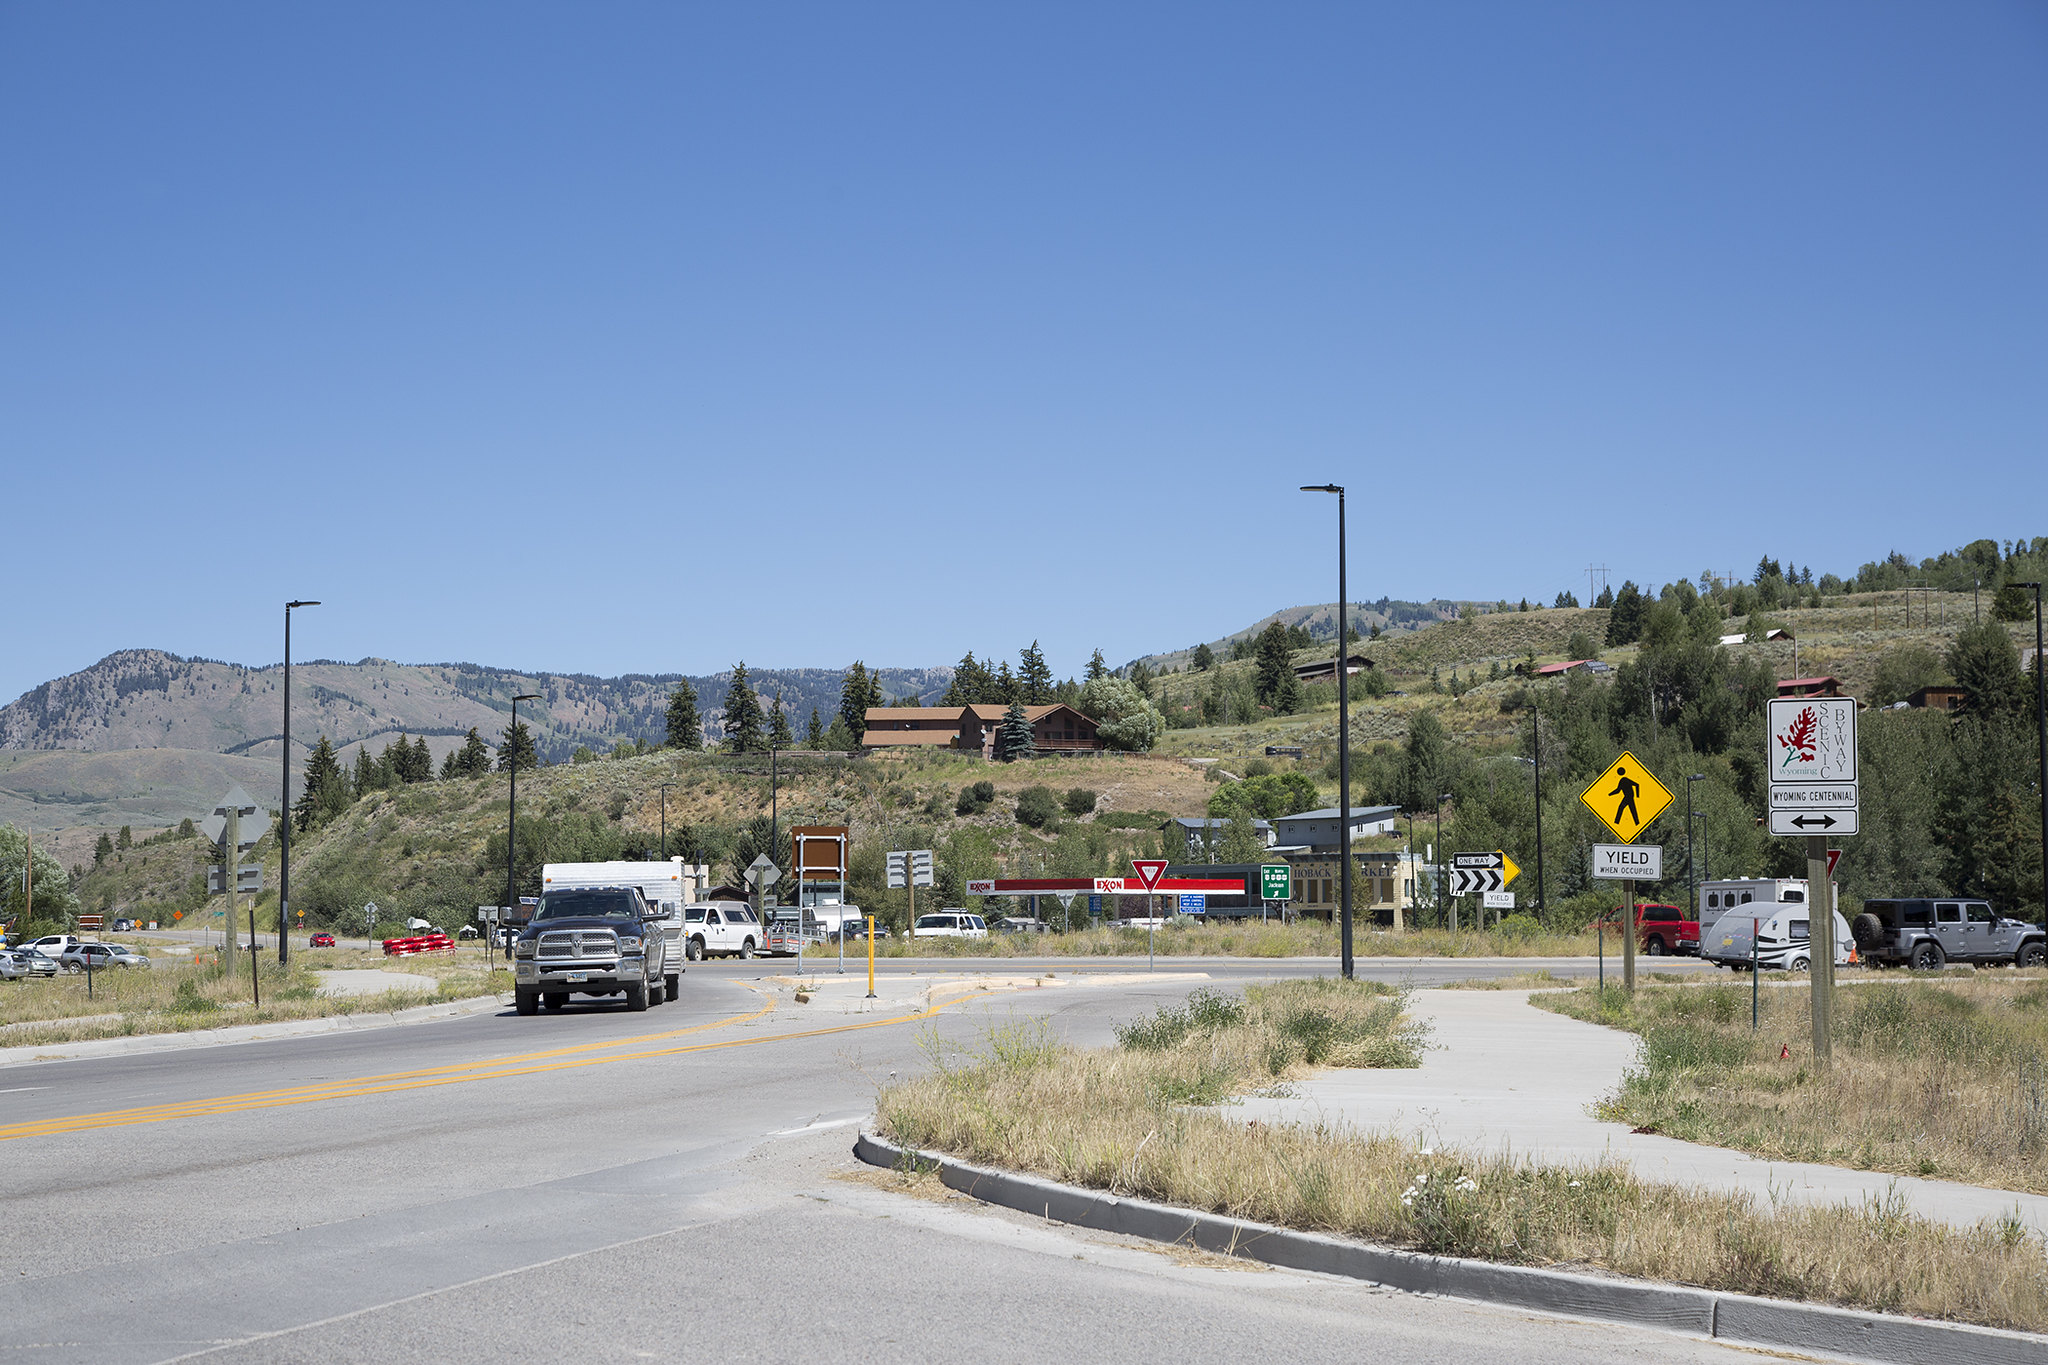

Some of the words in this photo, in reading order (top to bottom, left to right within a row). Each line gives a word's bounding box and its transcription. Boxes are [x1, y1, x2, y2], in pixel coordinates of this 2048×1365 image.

[1819, 702, 1831, 779] SCENIC
[1834, 708, 1847, 772] BYWAY
[1778, 766, 1818, 776] Wyoming
[1773, 791, 1806, 801] WYOMING
[1809, 791, 1854, 801] CENTENNIAL
[1606, 851, 1649, 864] YIELD
[1294, 868, 1332, 878] HOBACK
[1621, 867, 1654, 875] OCCUPIED
[970, 882, 991, 893] EXXON
[1096, 880, 1122, 893] EXXON
